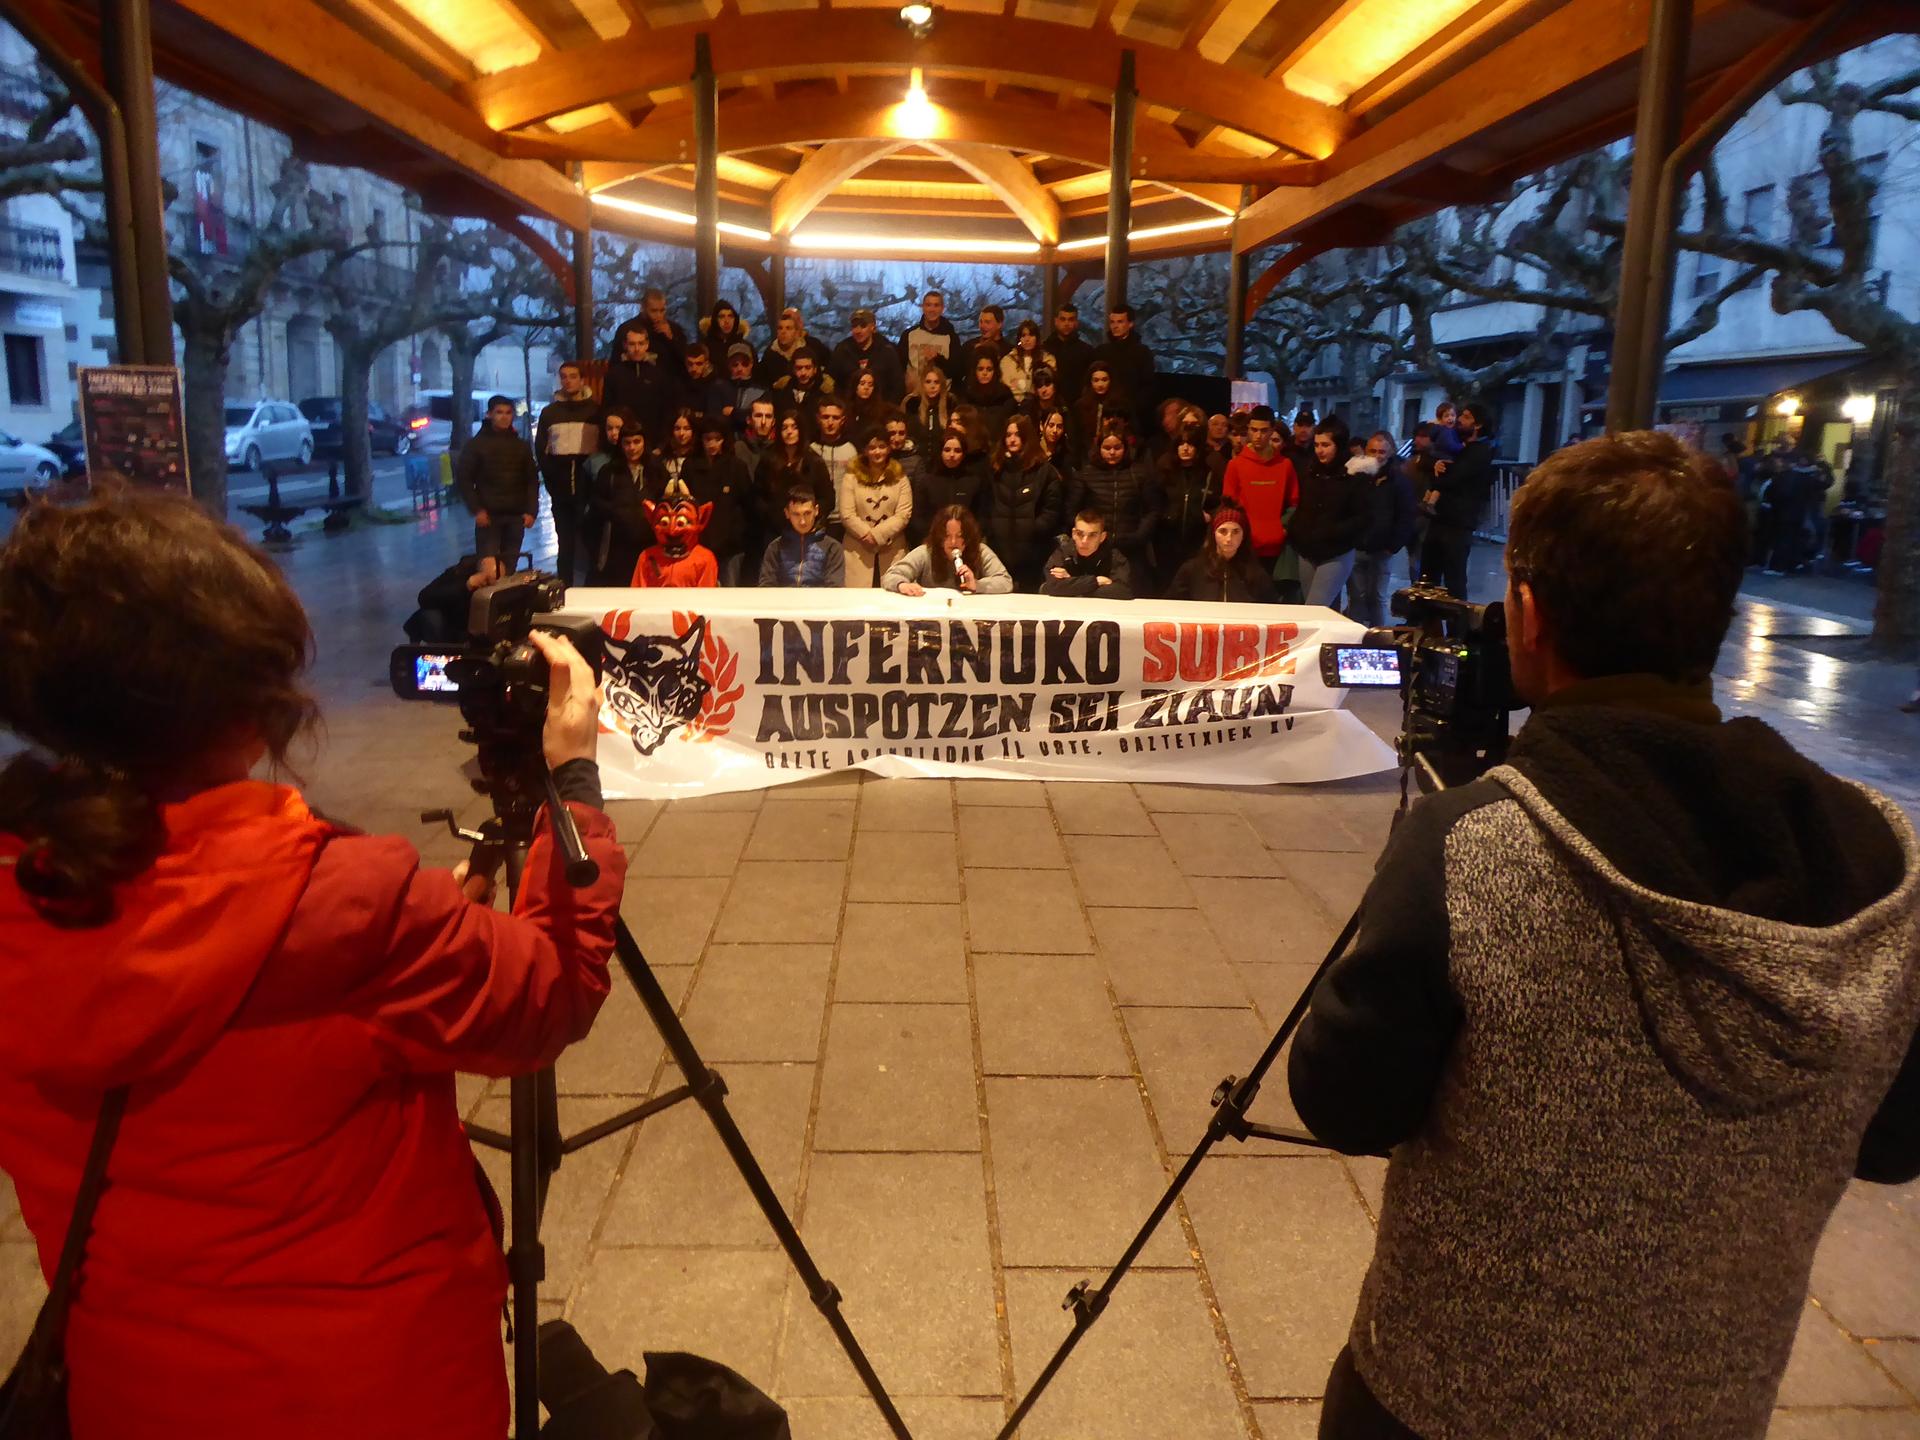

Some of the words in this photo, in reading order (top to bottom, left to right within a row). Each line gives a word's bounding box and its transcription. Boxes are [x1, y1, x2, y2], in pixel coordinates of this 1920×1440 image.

[753, 618, 1121, 685] INFERNUKO
[755, 690, 1037, 742] AUSPOTZEN
[1048, 690, 1125, 734] SEI
[1133, 683, 1296, 729] ZIAUN
